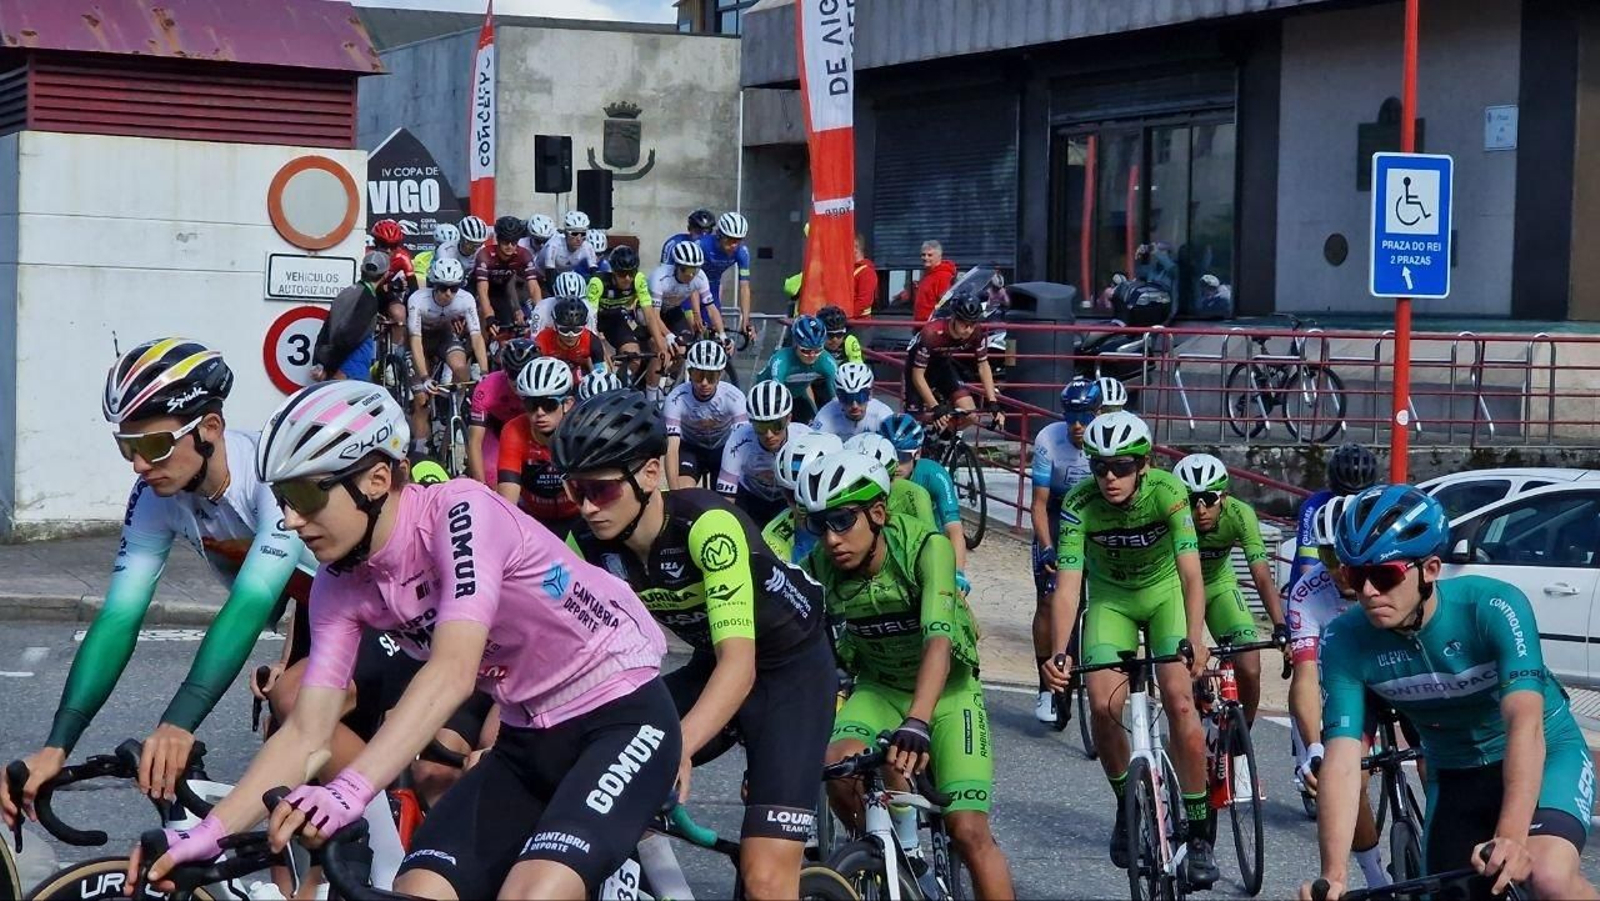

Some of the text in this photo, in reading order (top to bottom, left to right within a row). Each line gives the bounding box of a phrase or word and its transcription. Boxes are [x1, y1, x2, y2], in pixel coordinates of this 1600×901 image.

[381, 166, 439, 177] IV COPA DE
[368, 178, 440, 214] VIGO
[1381, 240, 1441, 252] PRAZA DO REI
[1390, 255, 1432, 266] 2 PRAZAS
[448, 501, 476, 600] GOMUR
[660, 561, 679, 570] IZA
[563, 597, 599, 634] DEPORTE
[572, 581, 619, 630] CANTABRIA
[1489, 597, 1527, 659] CONTROLPACK
[1383, 669, 1498, 697] ONTROLPAC
[585, 724, 665, 815] GOMUR
[949, 788, 988, 801] ZICO
[531, 841, 570, 853] DEPORTE
[534, 831, 591, 854] CANTABRIA
